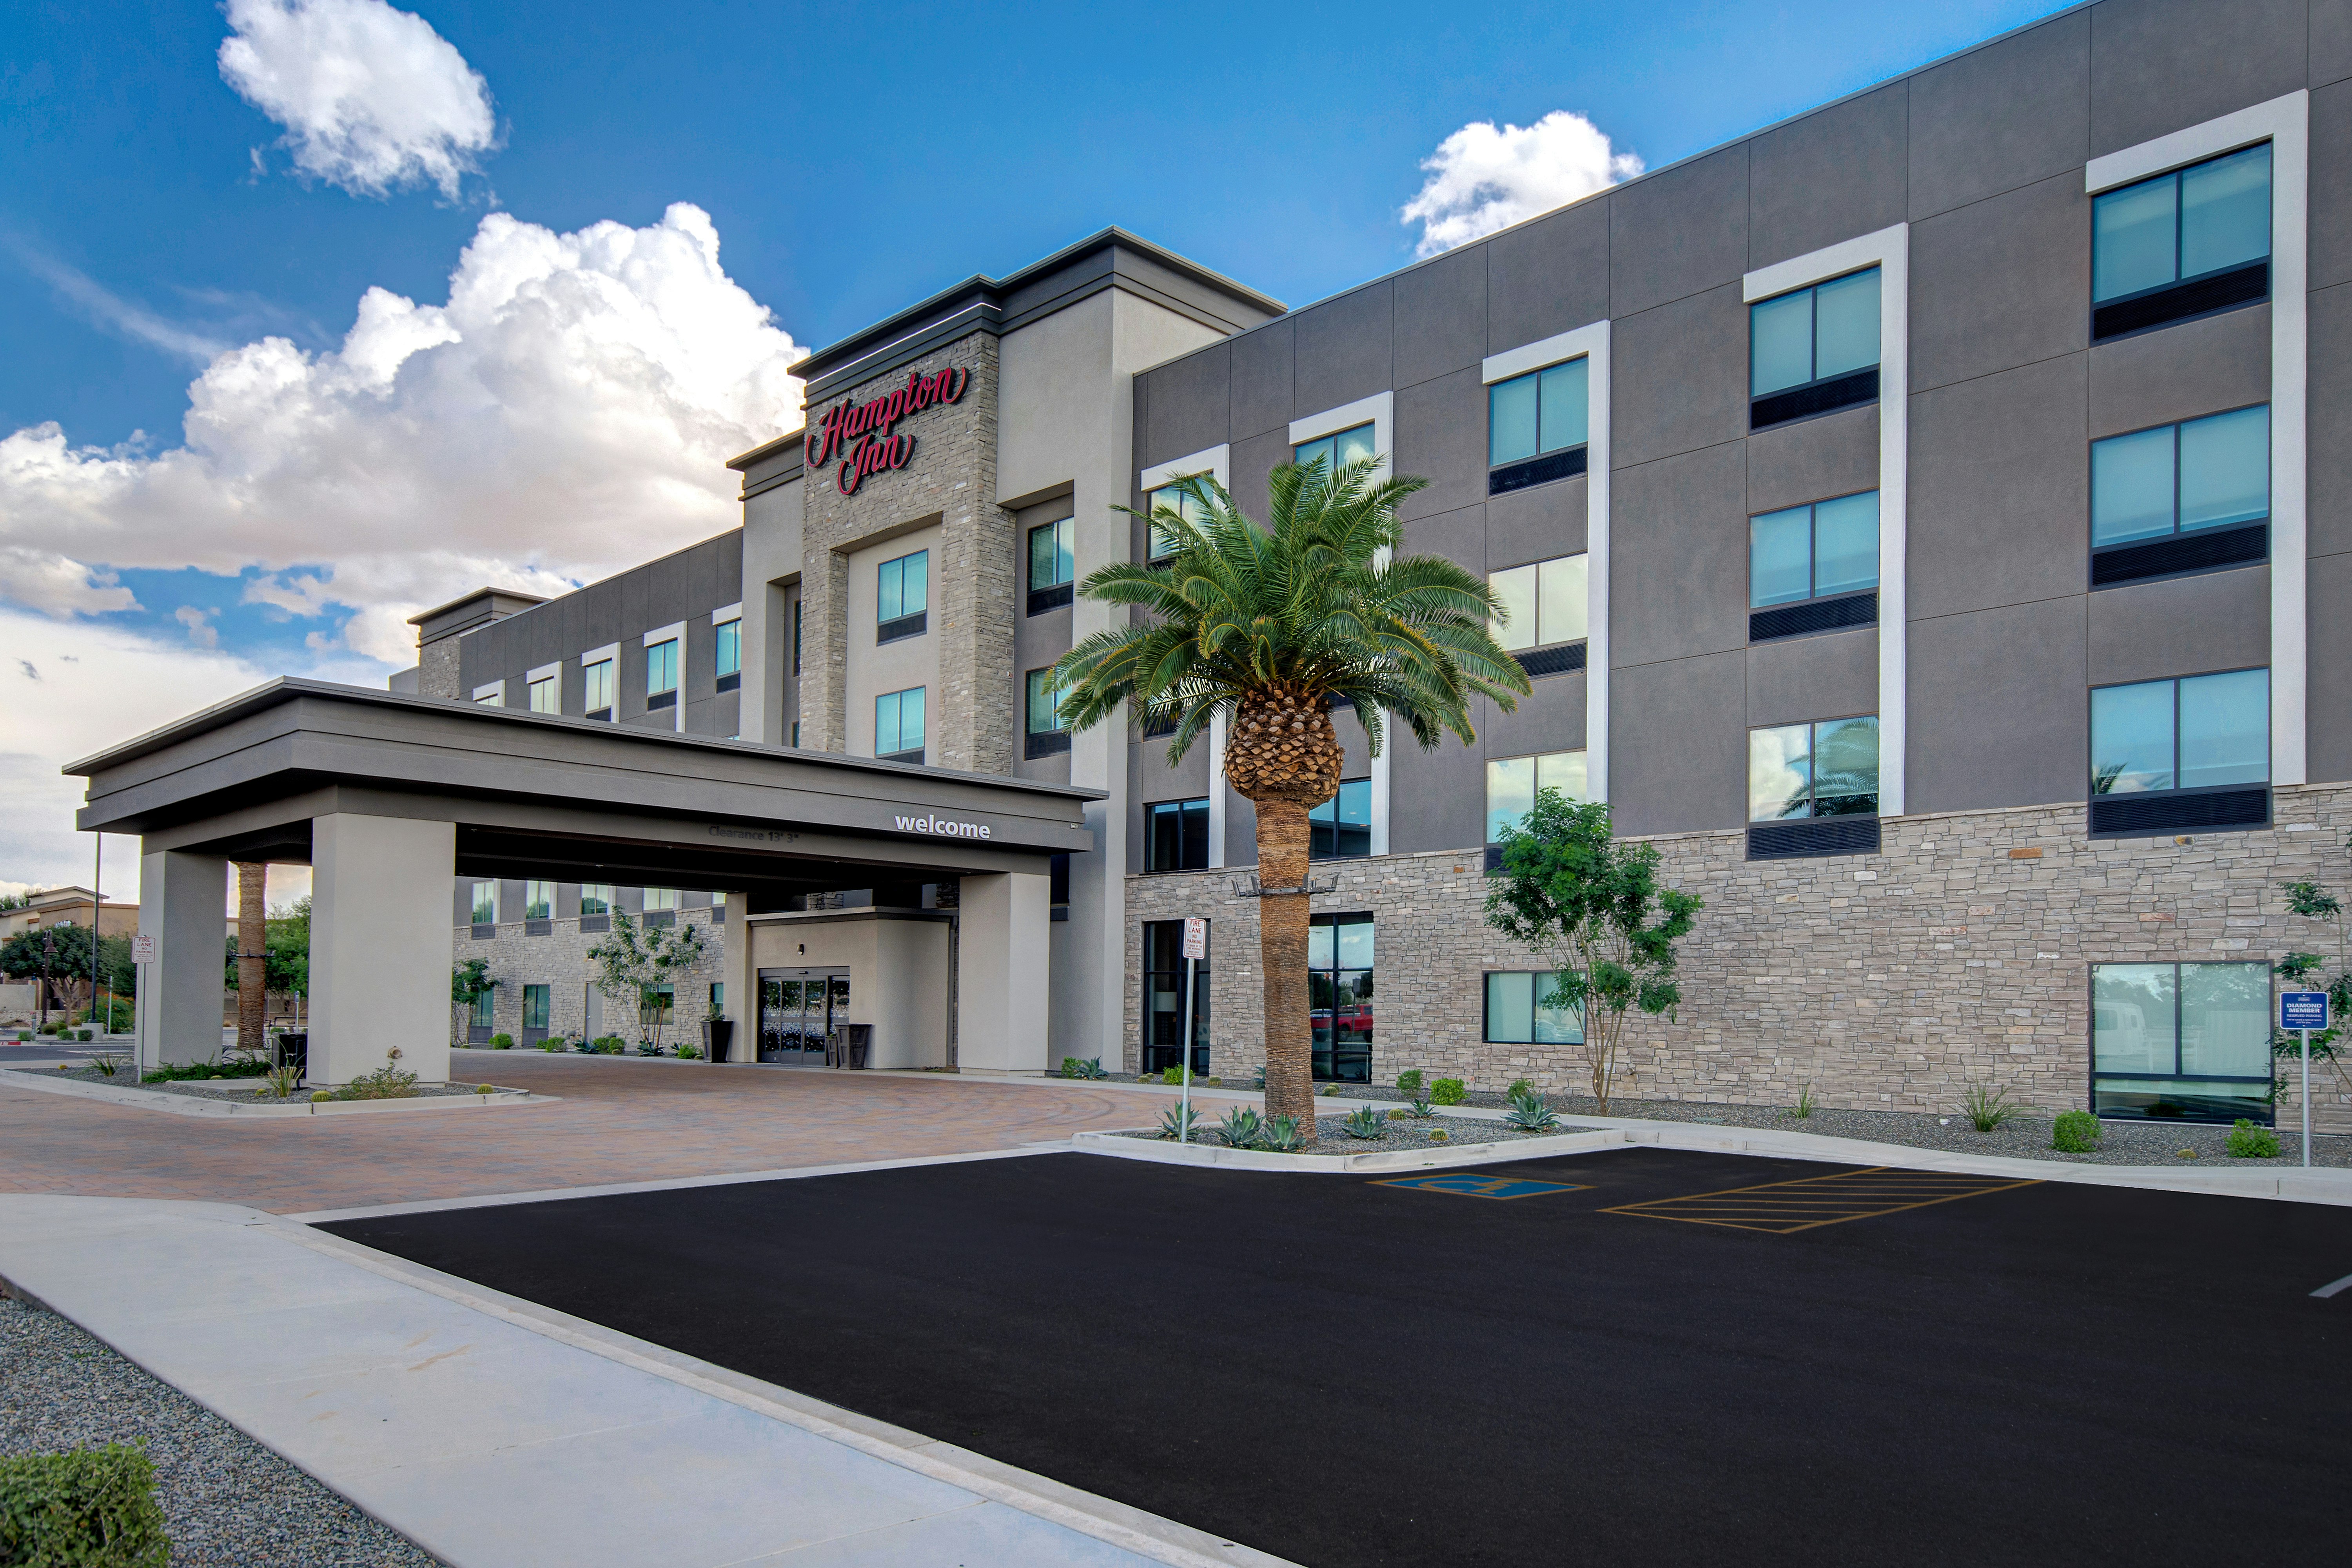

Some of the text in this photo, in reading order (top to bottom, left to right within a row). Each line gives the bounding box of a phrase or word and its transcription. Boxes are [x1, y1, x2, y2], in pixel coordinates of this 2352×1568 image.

[806, 367, 970, 468] Hampton
[838, 434, 917, 496] Inn
[708, 826, 764, 840] Clearance
[895, 814, 991, 839] welcome
